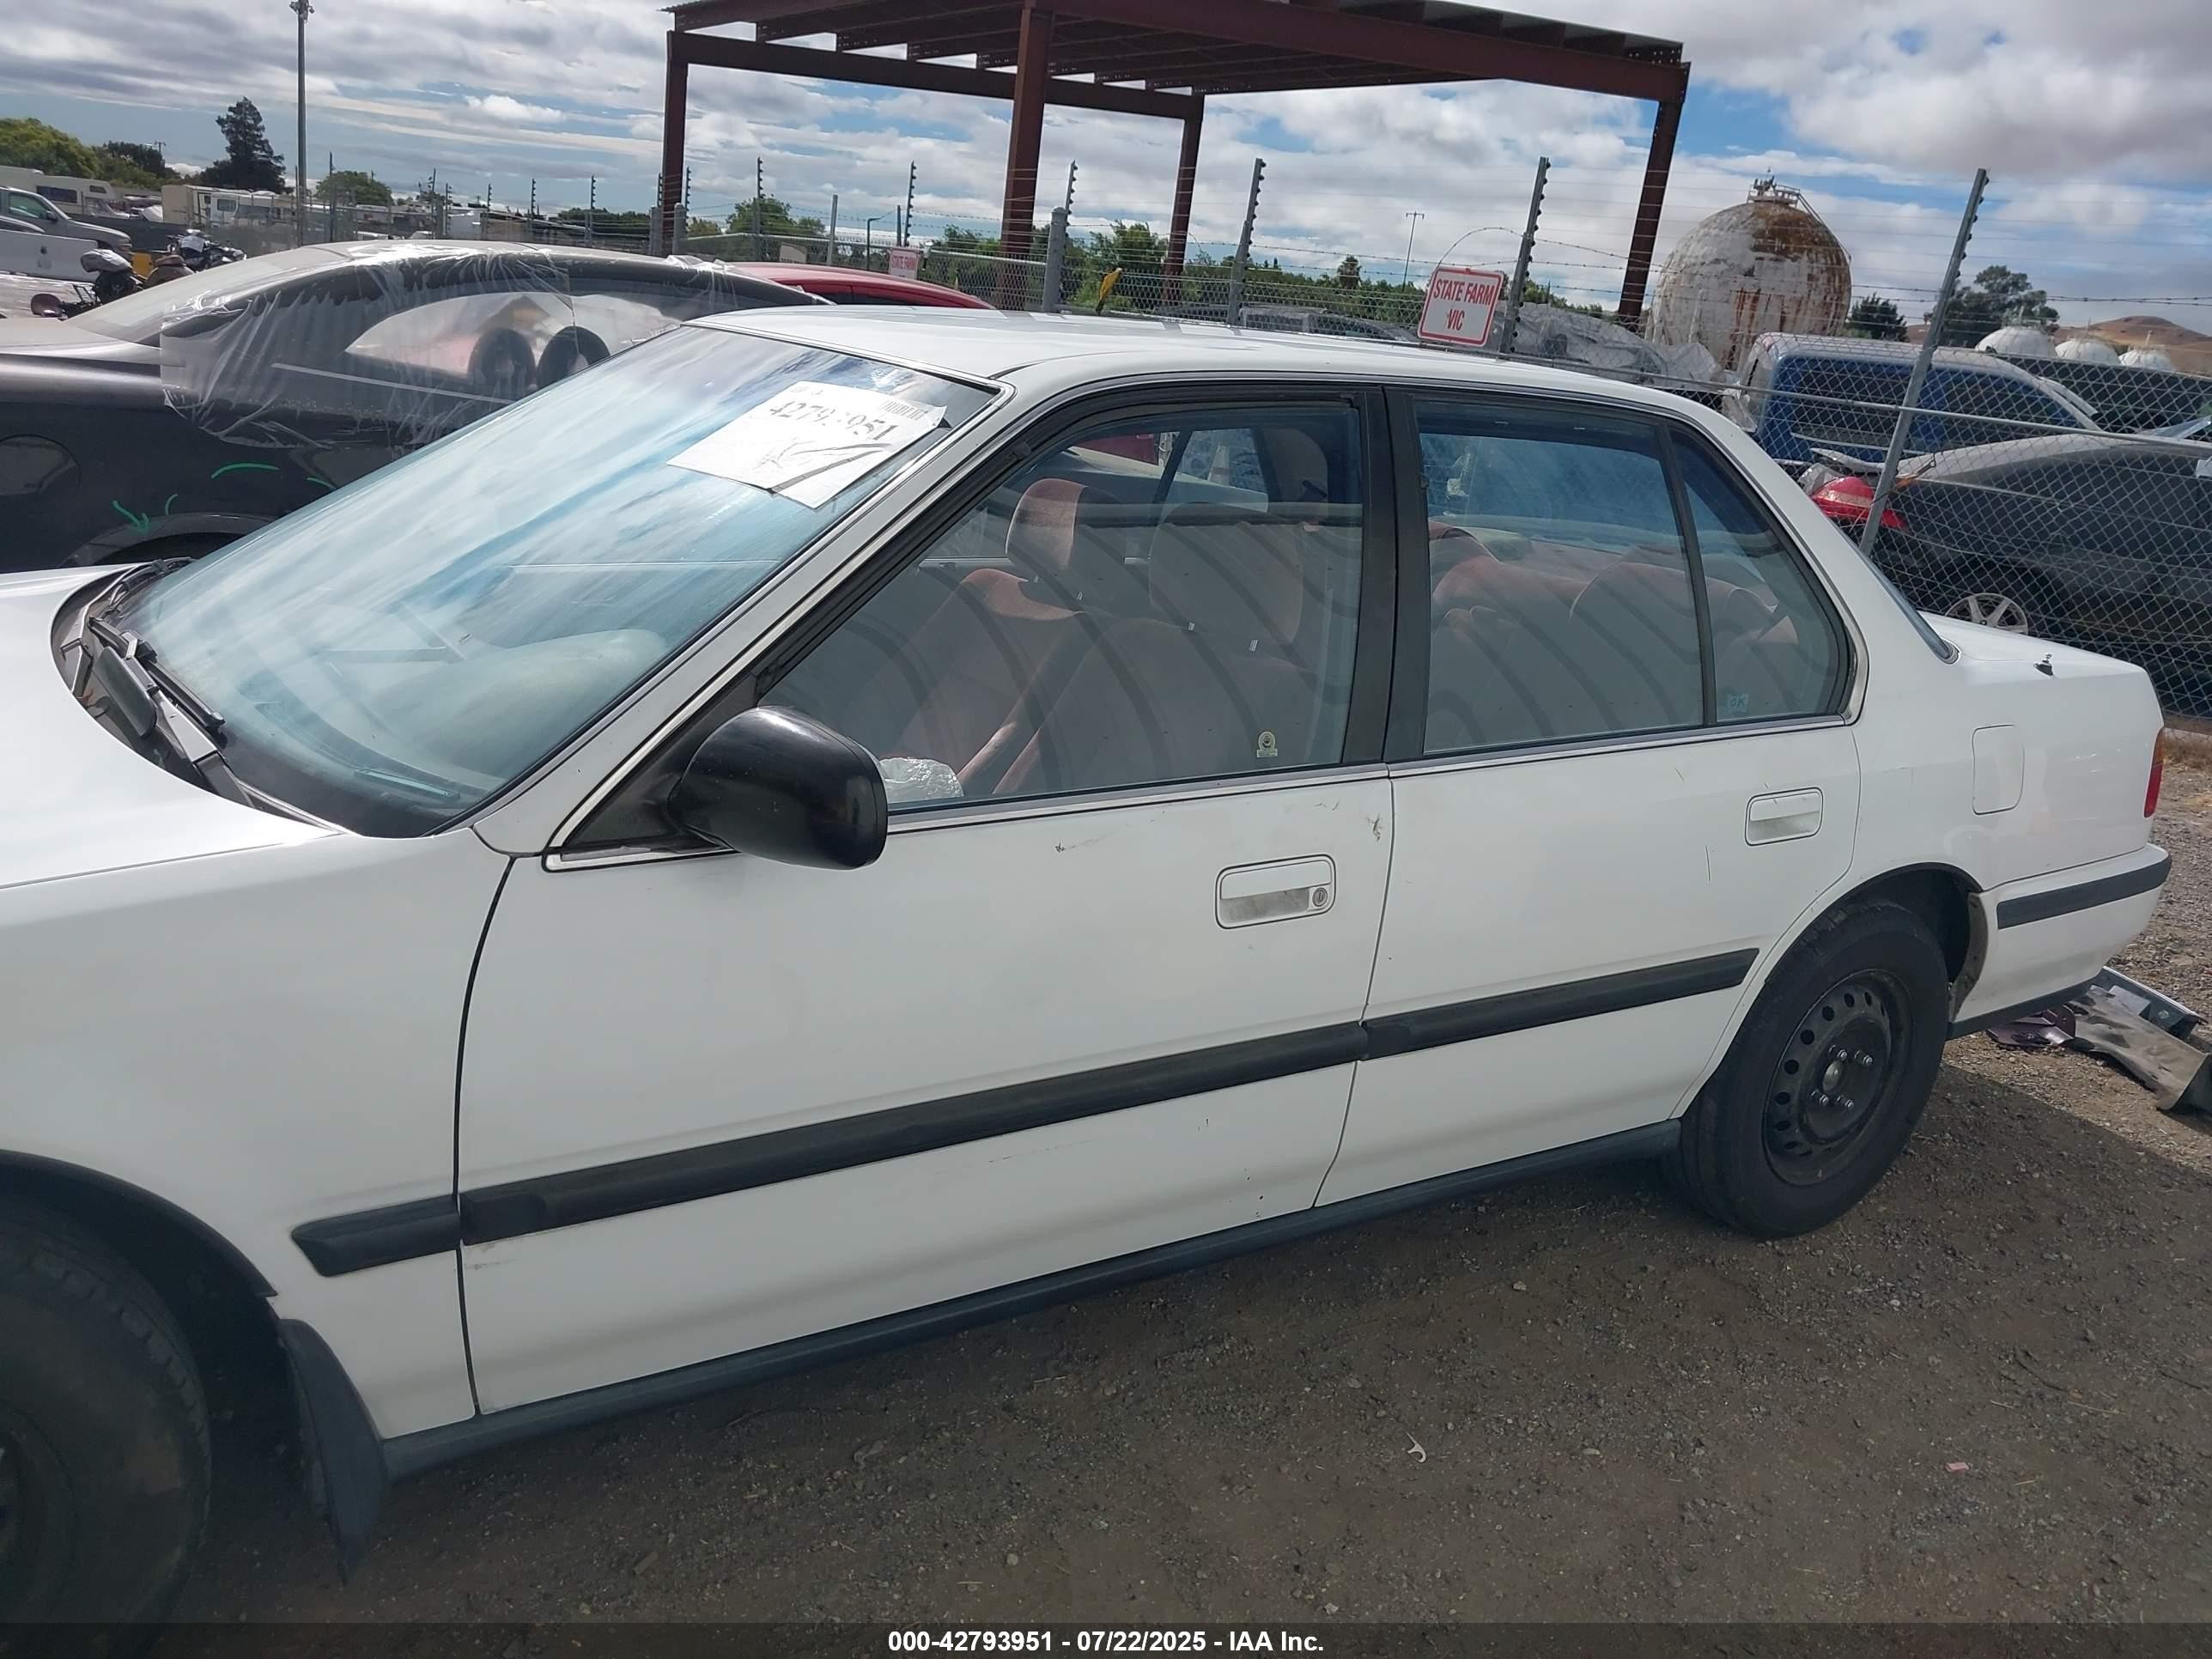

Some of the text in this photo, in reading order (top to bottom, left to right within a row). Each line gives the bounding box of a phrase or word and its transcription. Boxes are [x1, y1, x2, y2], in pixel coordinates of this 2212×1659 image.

[1433, 279, 1495, 306] STATE FARM
[1447, 308, 1465, 331] VIC
[769, 400, 899, 441] 4279951
